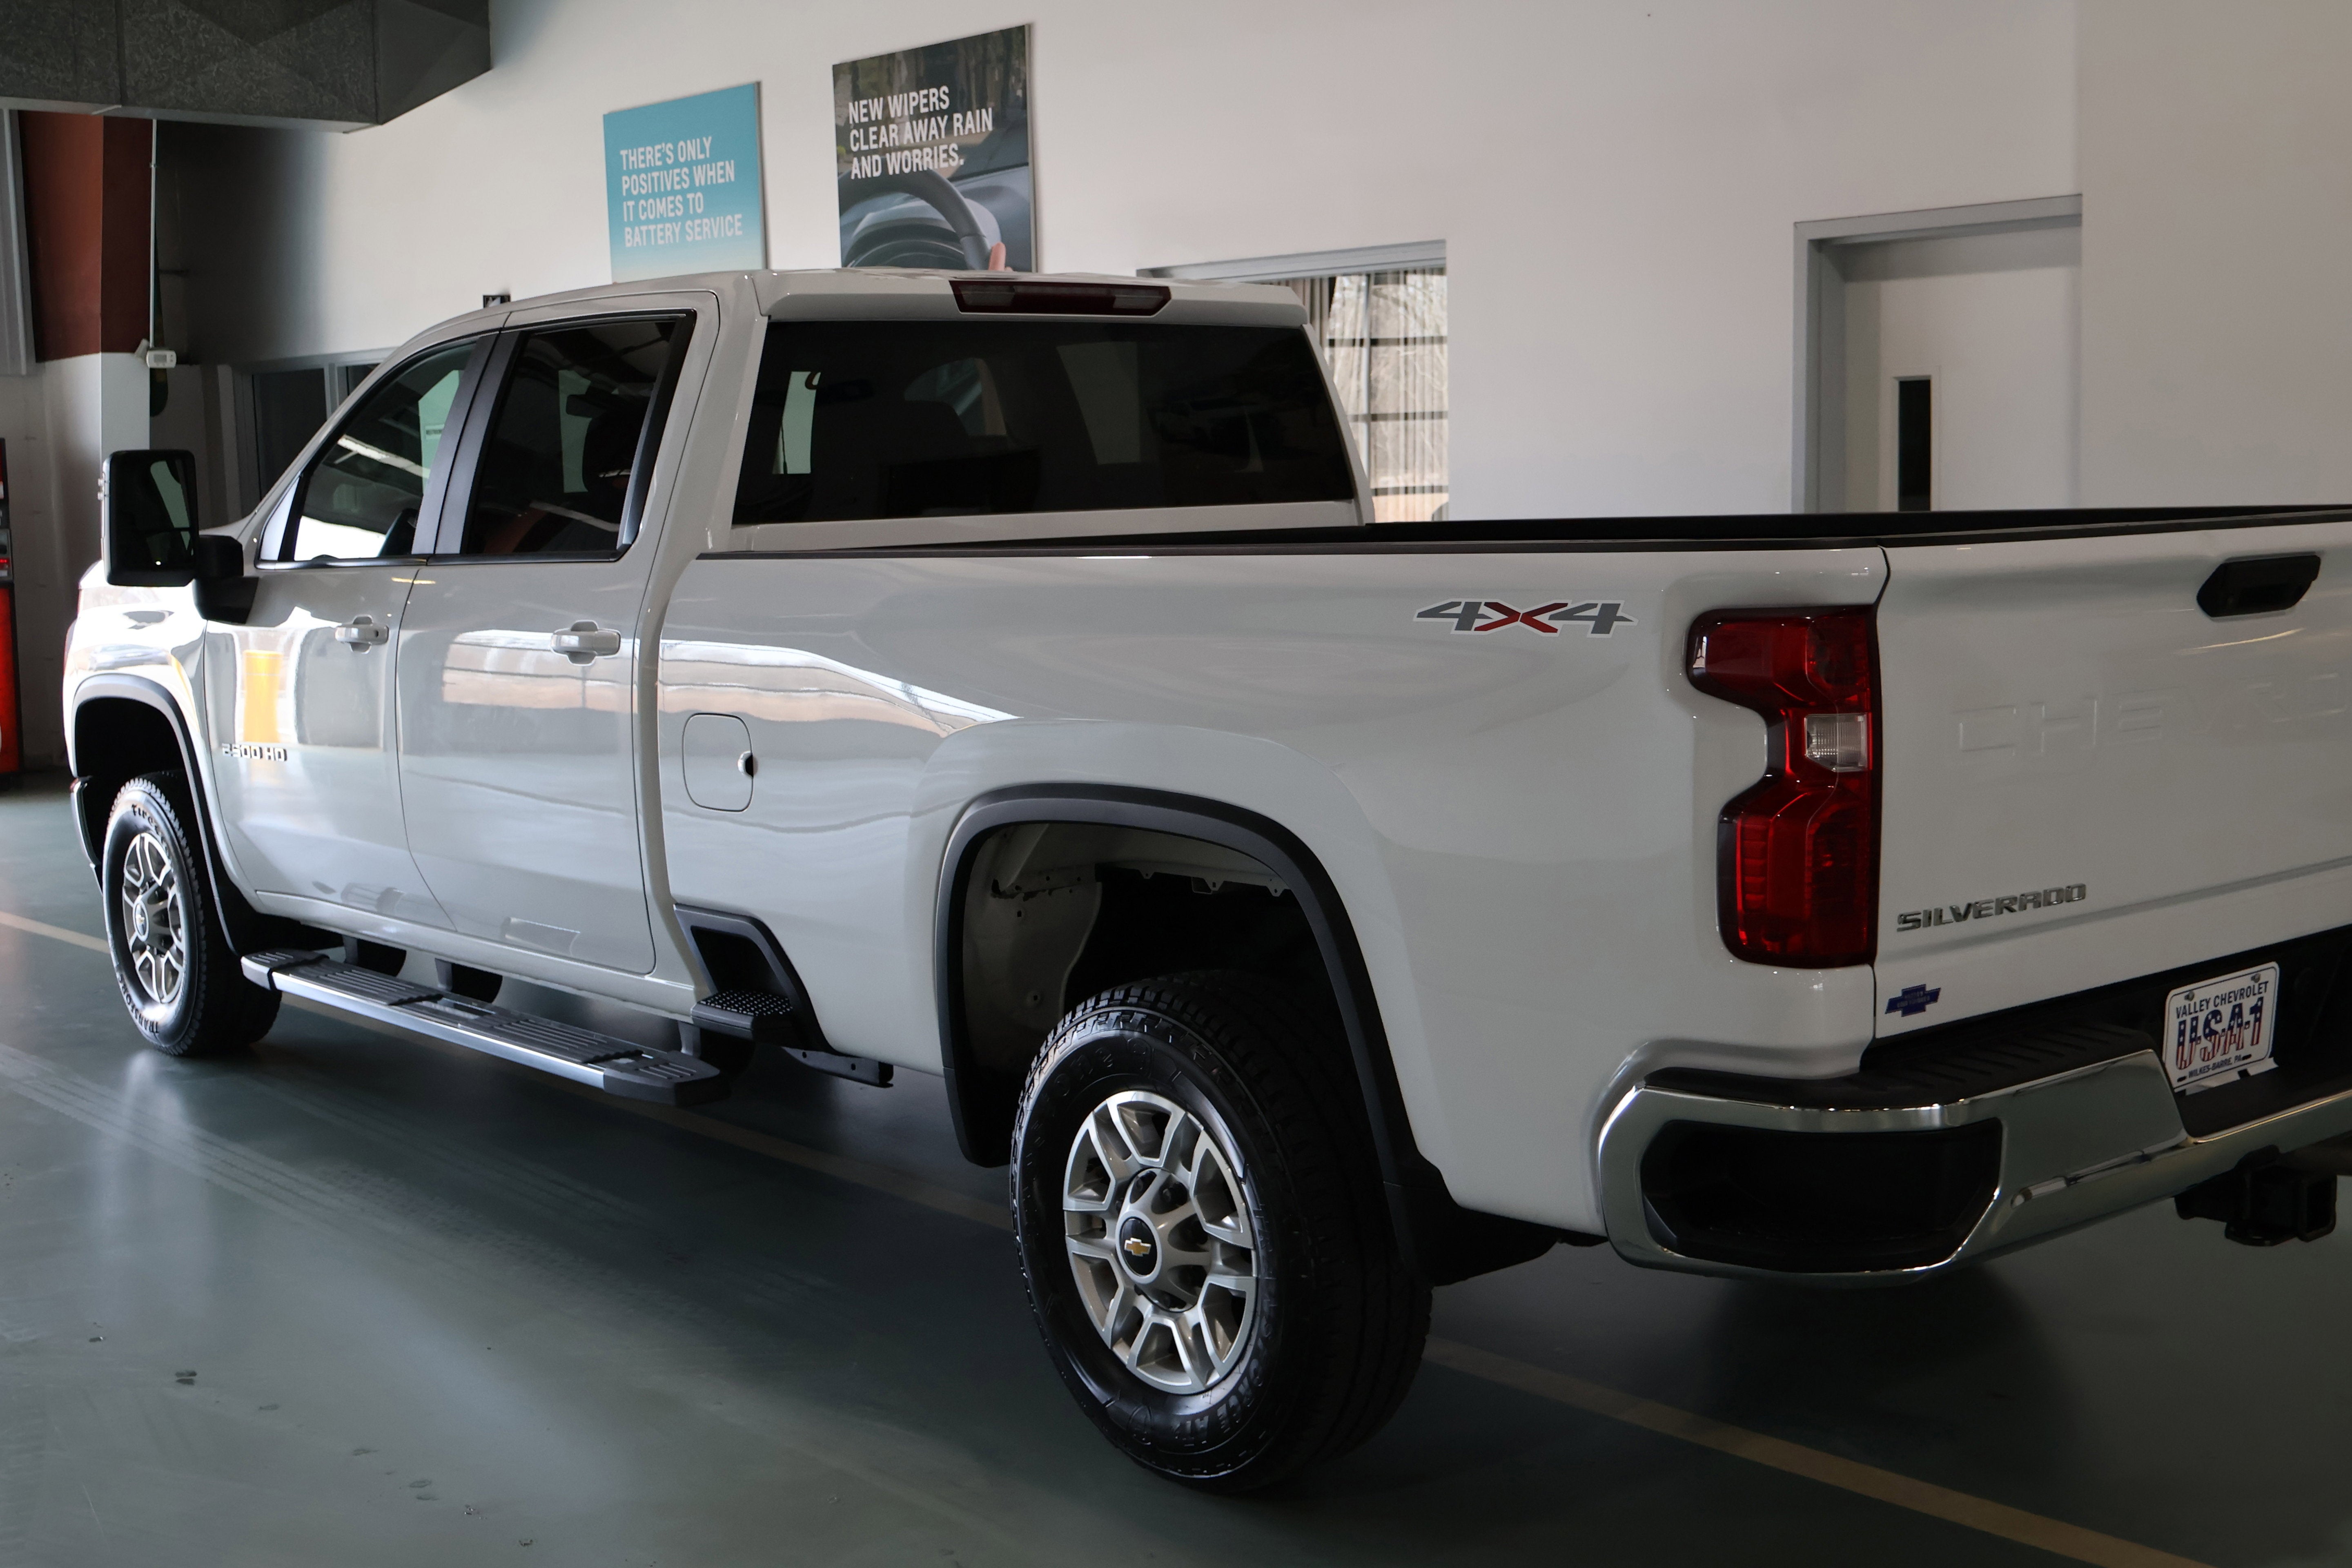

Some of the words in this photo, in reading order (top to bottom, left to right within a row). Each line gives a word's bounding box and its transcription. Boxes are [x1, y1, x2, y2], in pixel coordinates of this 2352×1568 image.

[849, 97, 884, 124] NEW
[888, 85, 950, 118] WIPERS
[850, 124, 898, 152] CLEAR
[903, 115, 949, 145] AWAY
[953, 107, 993, 136] RAIN
[620, 143, 674, 170] THERE'S
[677, 136, 712, 163] ONLY
[851, 155, 882, 180] AND
[886, 143, 964, 176] WORRIES.
[622, 167, 690, 196] POSITIVES
[693, 160, 735, 187] WHEN
[623, 201, 635, 222] IT
[639, 194, 684, 220] COMES
[687, 192, 704, 214] TO
[624, 222, 682, 247] BATTERY
[685, 214, 743, 242] SERVICE
[222, 743, 263, 760] 2500
[265, 746, 287, 762] HD
[1897, 883, 2086, 932] SILVERADO
[2176, 997, 2211, 1019] VALLEY
[2214, 980, 2269, 1008] CHEVROLET
